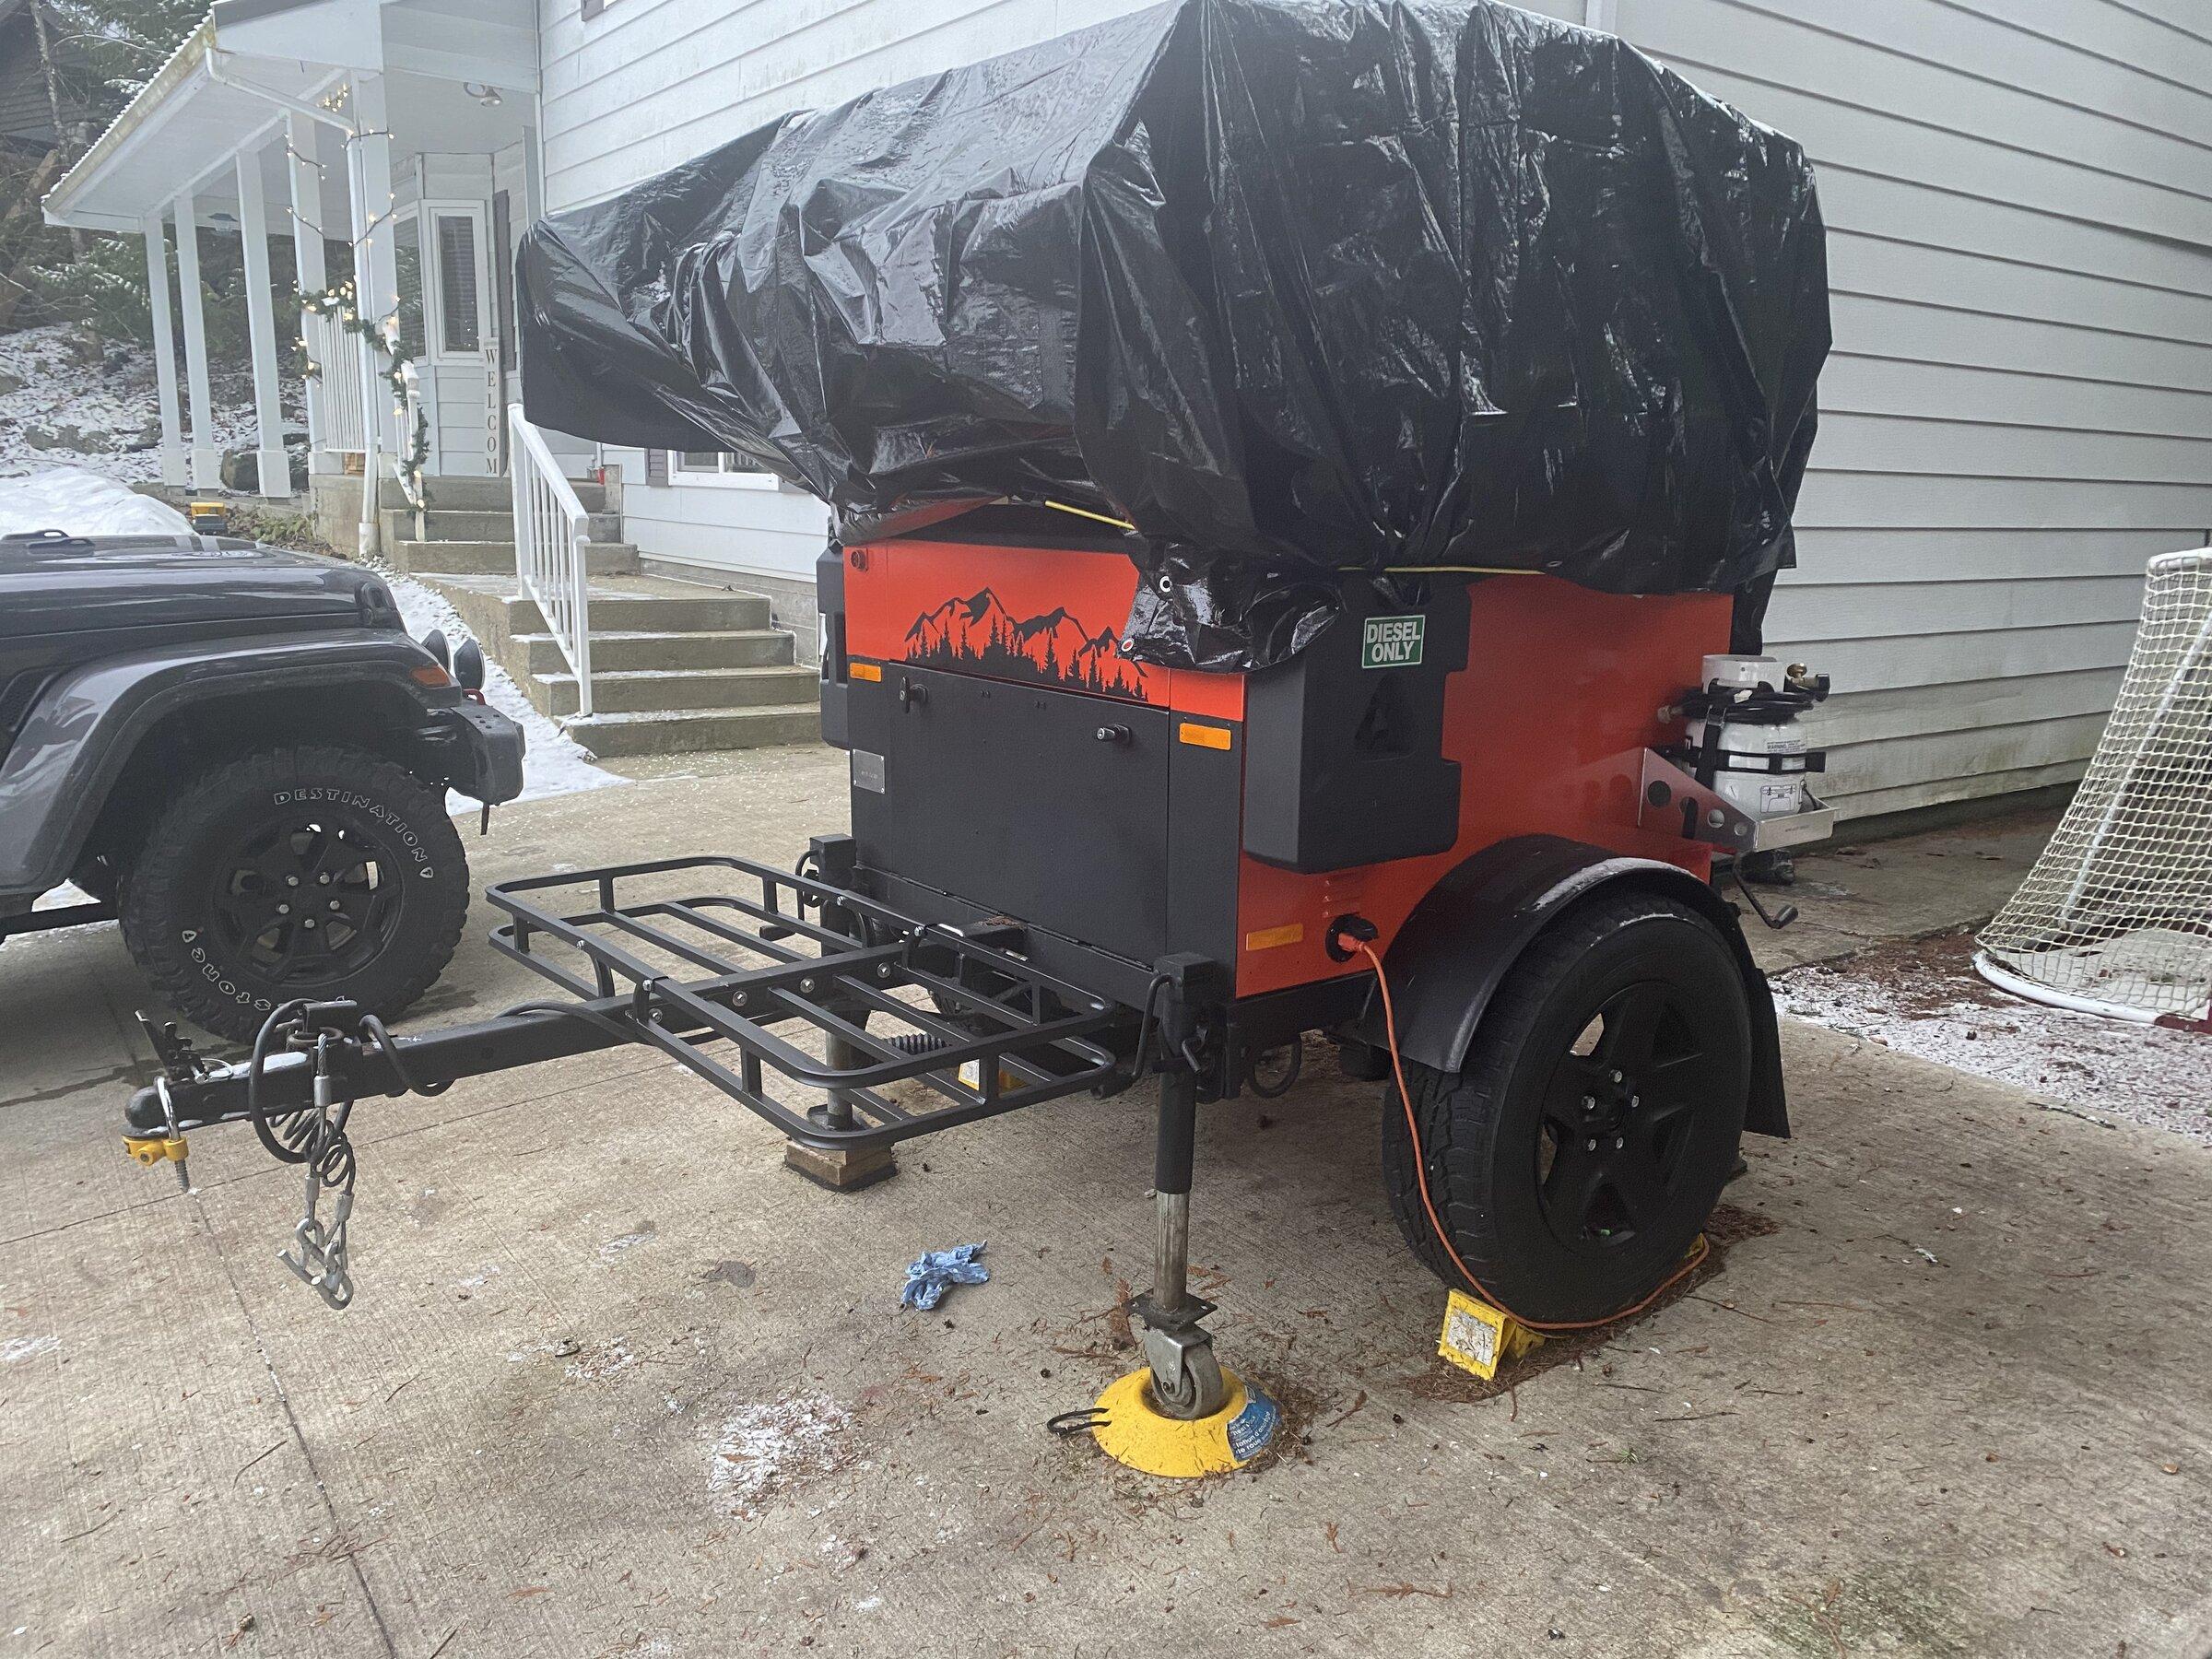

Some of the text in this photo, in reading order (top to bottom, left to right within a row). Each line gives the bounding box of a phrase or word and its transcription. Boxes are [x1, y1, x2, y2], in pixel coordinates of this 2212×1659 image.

[485, 348, 499, 475] WELCOM
[1367, 621, 1420, 644] DIESEL
[1371, 641, 1415, 663] ONLY
[273, 787, 429, 865] DESTINATION
[191, 947, 272, 1012] stone
